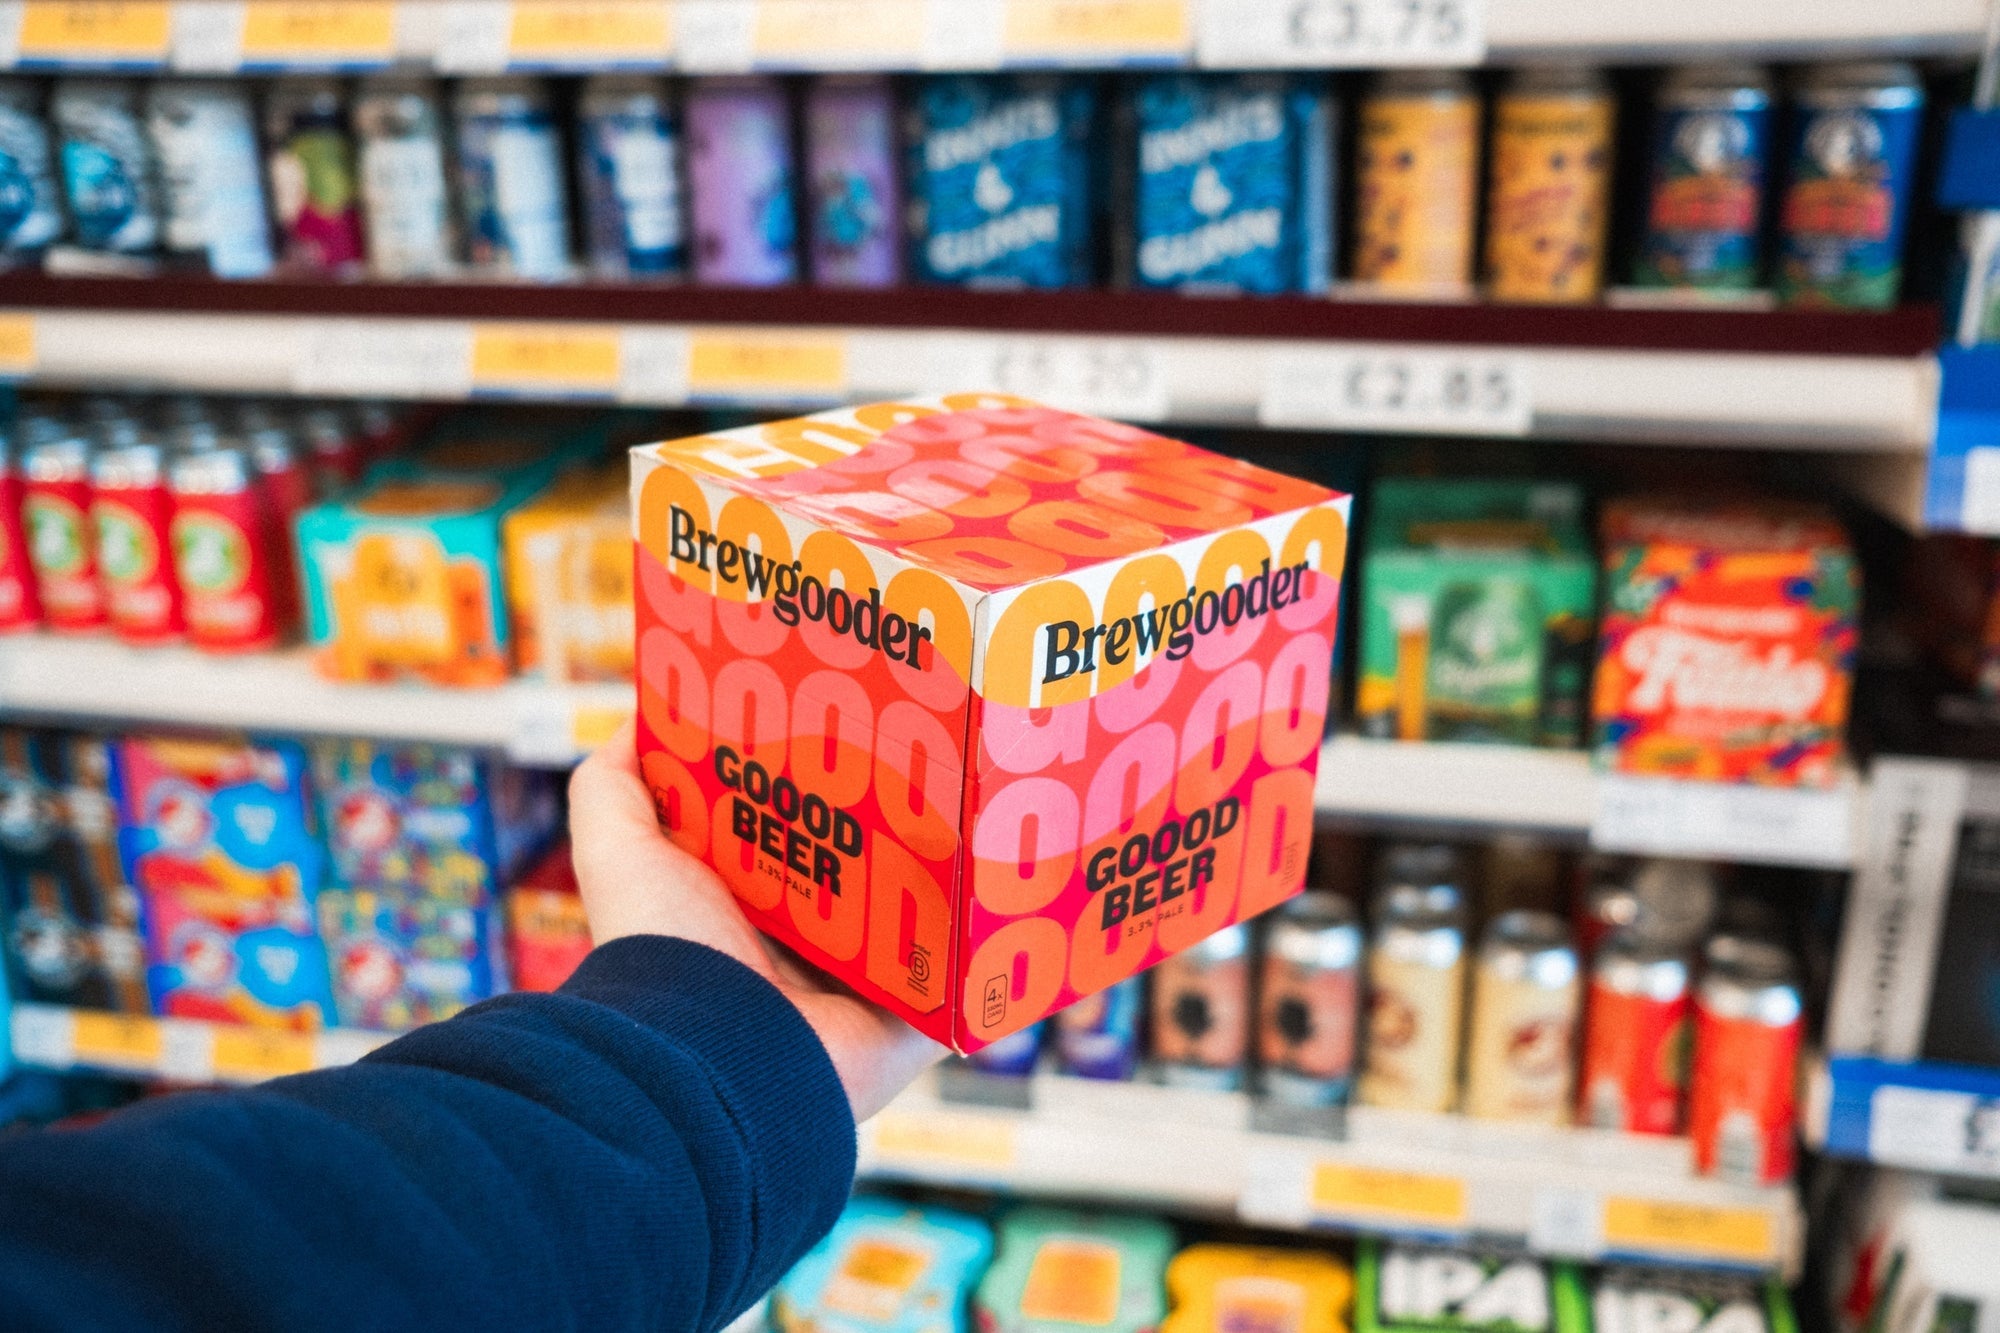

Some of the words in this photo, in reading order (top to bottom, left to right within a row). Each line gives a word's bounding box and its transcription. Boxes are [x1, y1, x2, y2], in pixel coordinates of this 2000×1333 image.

[669, 504, 932, 671] Brewgooder
[1042, 558, 1309, 685] Brewgooder
[714, 745, 863, 858] GOOOD
[732, 796, 841, 898] BEER
[1086, 796, 1240, 892] GOOOD
[758, 859, 781, 881] 3.3%
[785, 875, 811, 900] PALE
[1101, 847, 1217, 931] BEER
[1127, 919, 1153, 937] 3.3%
[1158, 903, 1184, 920] PALE
[1382, 1250, 1549, 1328] IPA
